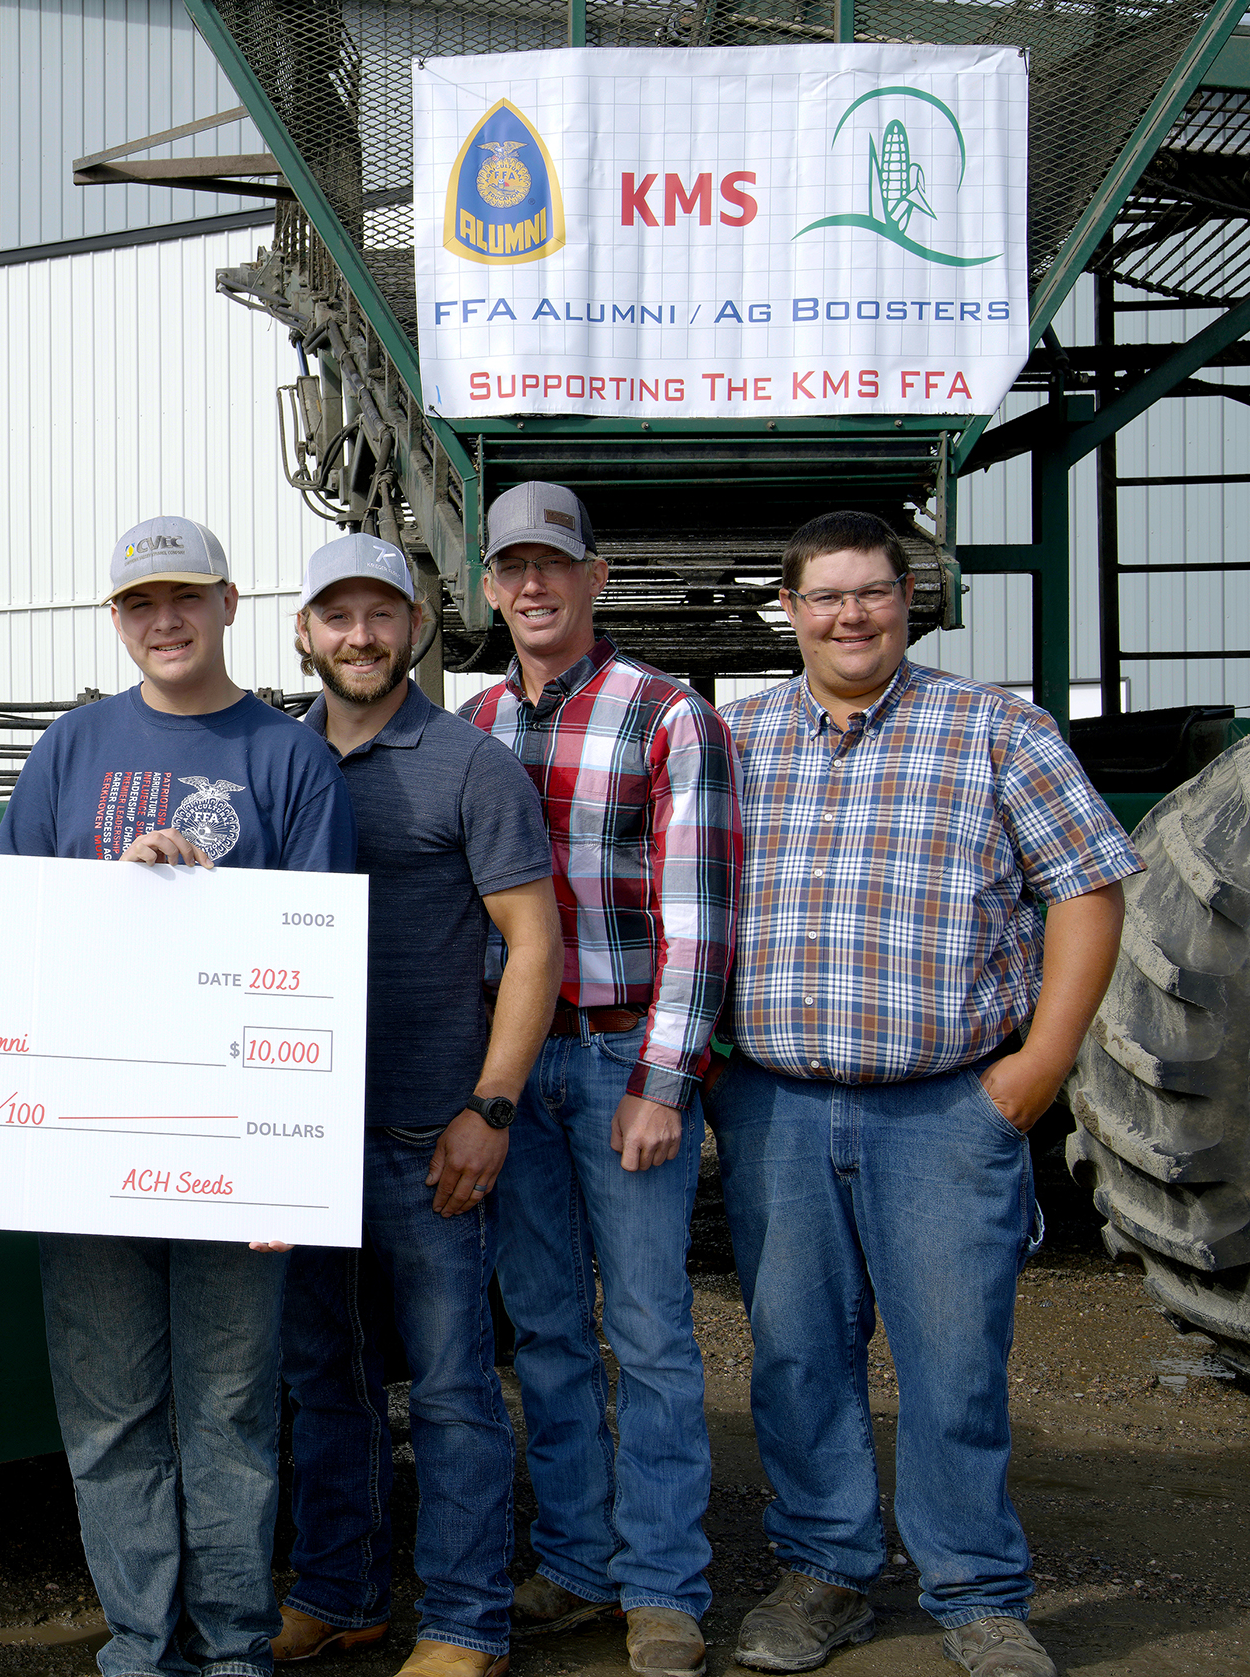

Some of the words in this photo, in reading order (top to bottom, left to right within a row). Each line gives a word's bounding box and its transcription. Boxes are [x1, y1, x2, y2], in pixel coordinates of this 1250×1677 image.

[494, 171, 516, 180] FFA
[621, 171, 757, 227] KMS
[460, 207, 547, 254] ALUMNI
[435, 299, 516, 324] FFA
[532, 299, 674, 324] ALUMNI
[690, 305, 700, 324] /
[714, 301, 770, 323] AG
[793, 298, 1009, 322] BOOSTERS
[470, 371, 684, 402] SUPPORTING
[702, 374, 771, 401] THE
[793, 370, 879, 399] KMS
[901, 371, 972, 399] FFA
[137, 535, 184, 553] CVEC
[94, 772, 113, 829] KERKHOVEN
[108, 772, 122, 802] CAREER
[118, 772, 132, 804] PREMIER
[126, 772, 142, 822] LEADERSHIP
[136, 772, 152, 816] INFLUENCE
[147, 772, 162, 818] AGRICULTURE
[157, 772, 172, 826] PATRIOTISM
[103, 804, 116, 844] SUCCESS
[113, 806, 125, 854] LEADERSHIP
[194, 811, 219, 823] FFA
[282, 912, 335, 928] 10002
[198, 972, 242, 987] DATE
[249, 968, 301, 991] 2023
[229, 1041, 240, 1059] $
[246, 1040, 320, 1065] 10,000
[246, 1121, 325, 1139] DOLLARS
[121, 1169, 170, 1193] ACH
[176, 1171, 234, 1196] Seeds
